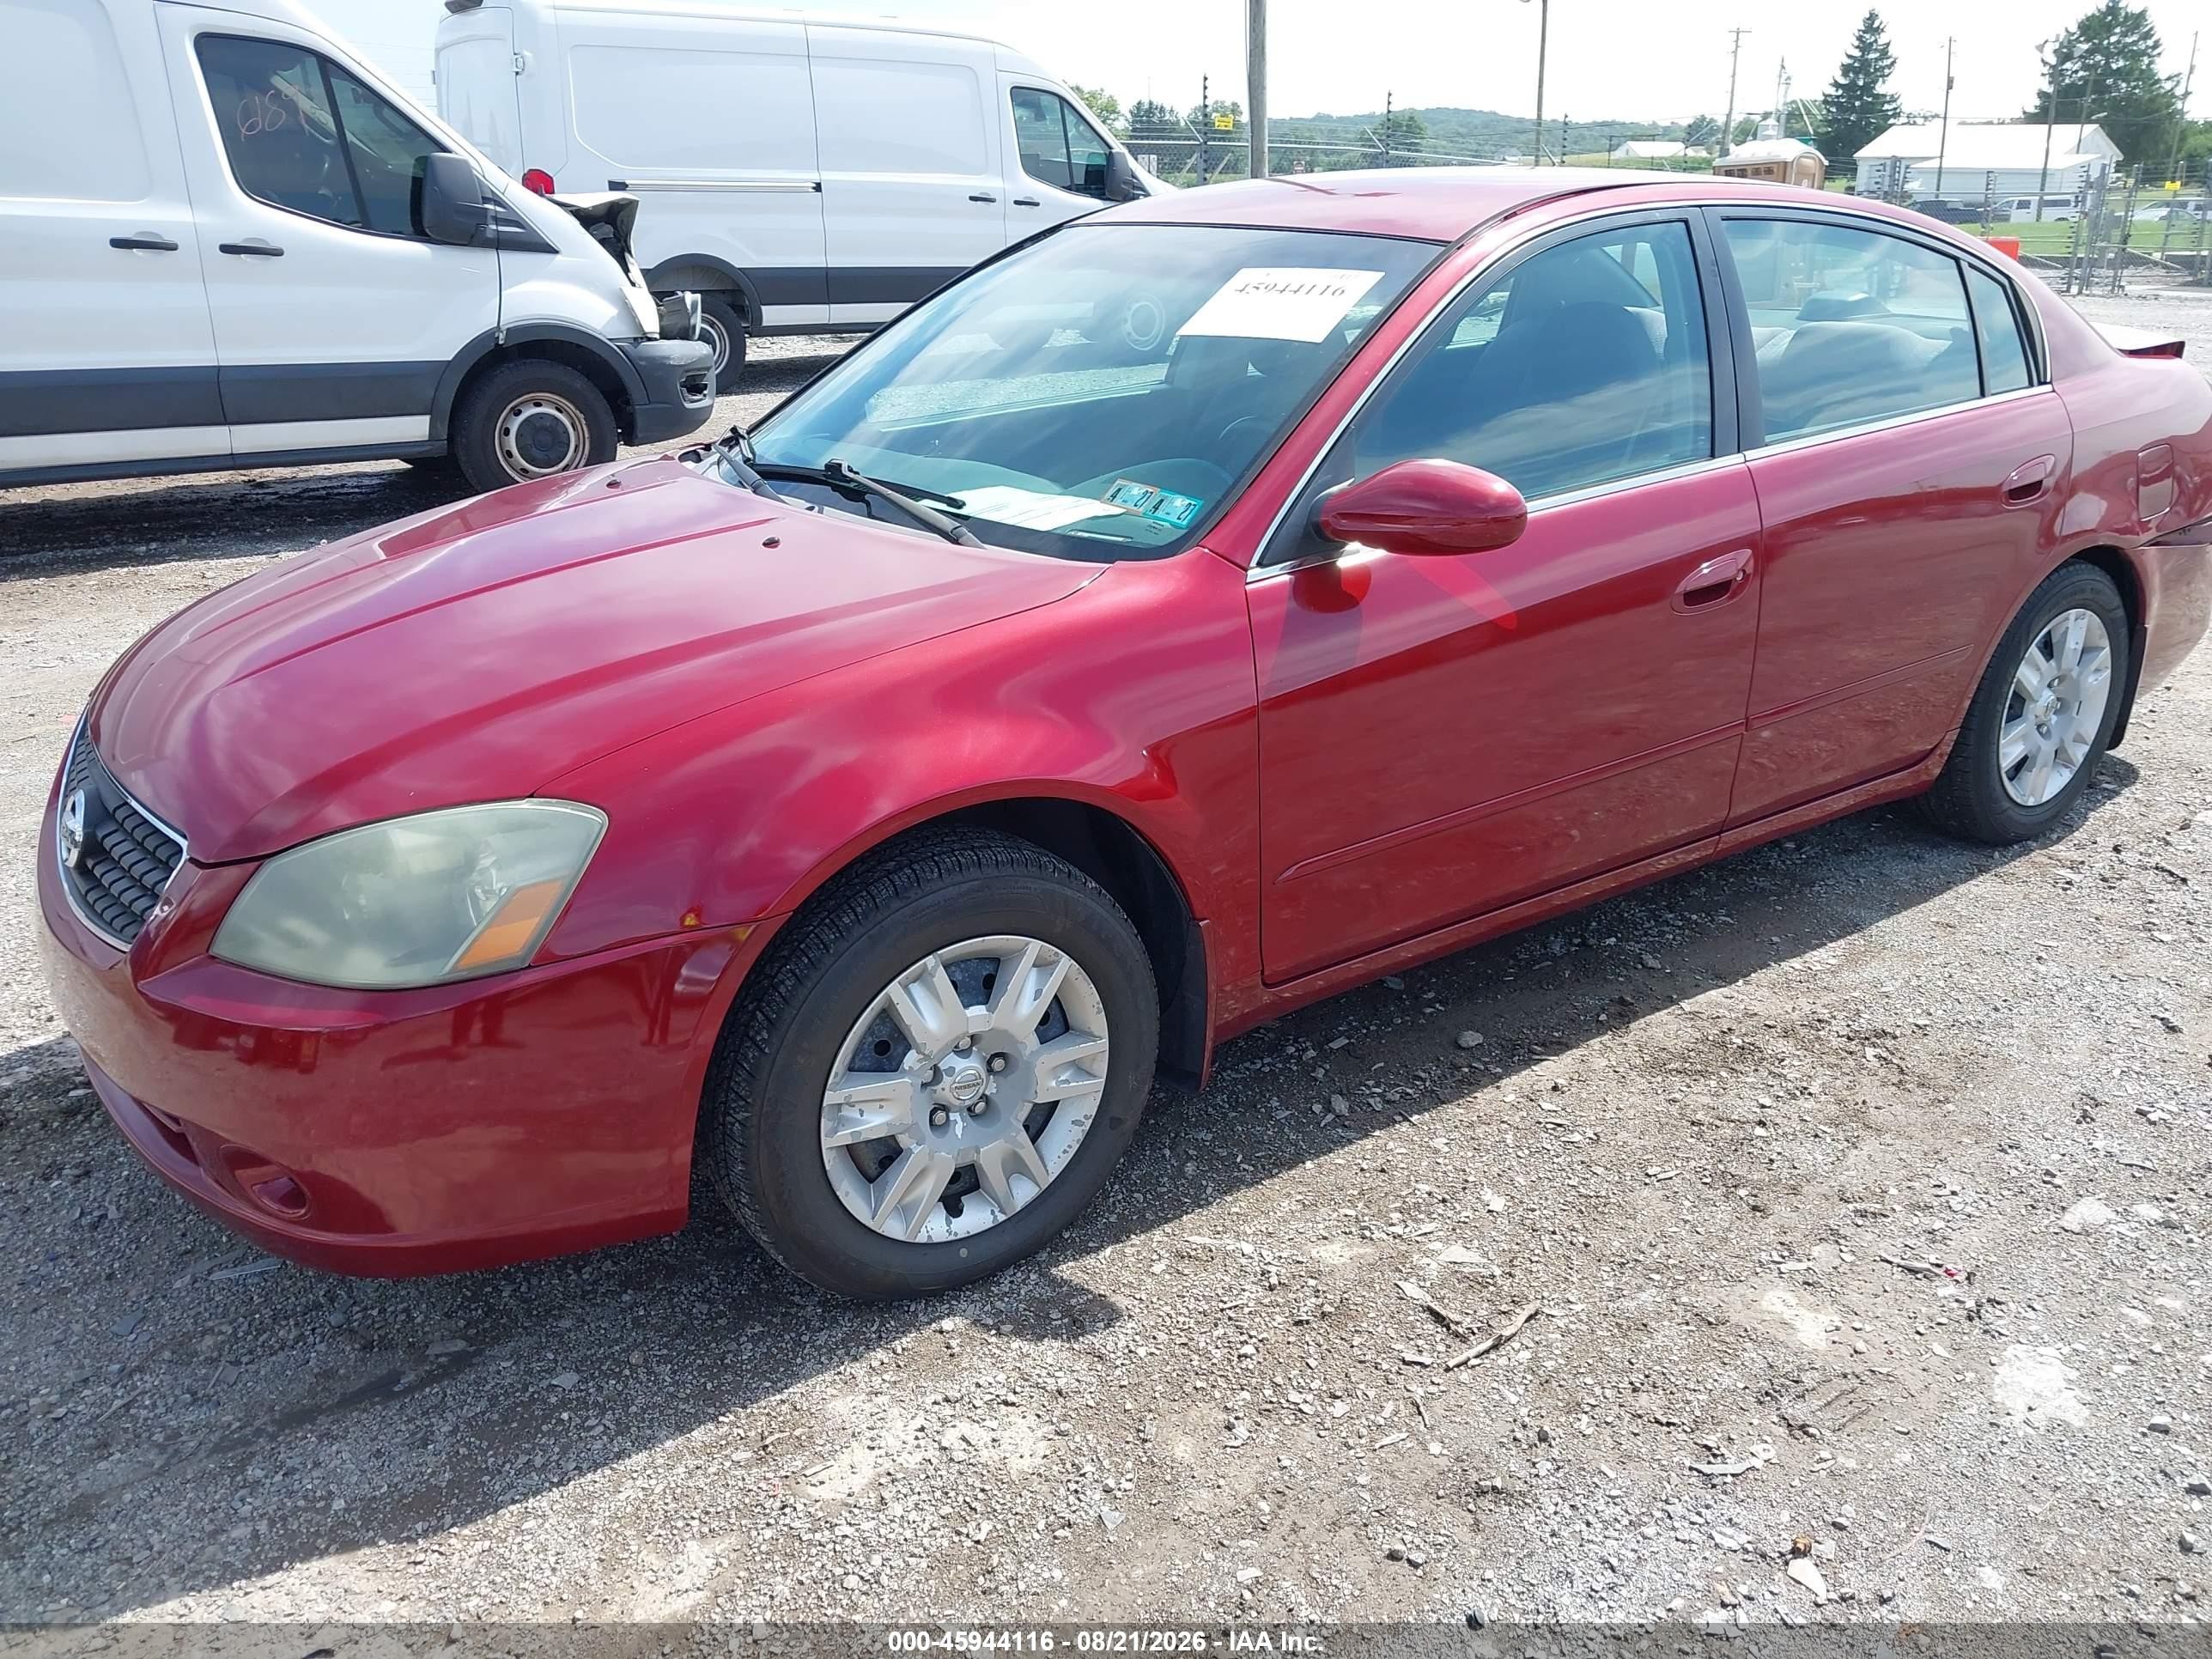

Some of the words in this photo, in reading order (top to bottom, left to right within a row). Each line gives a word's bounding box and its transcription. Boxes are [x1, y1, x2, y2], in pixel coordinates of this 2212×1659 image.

[1234, 282, 1346, 297] 45944116
[1107, 487, 1122, 502] 4
[1133, 489, 1154, 509] 27
[1149, 498, 1164, 514] 4
[1176, 501, 1197, 521] 27
